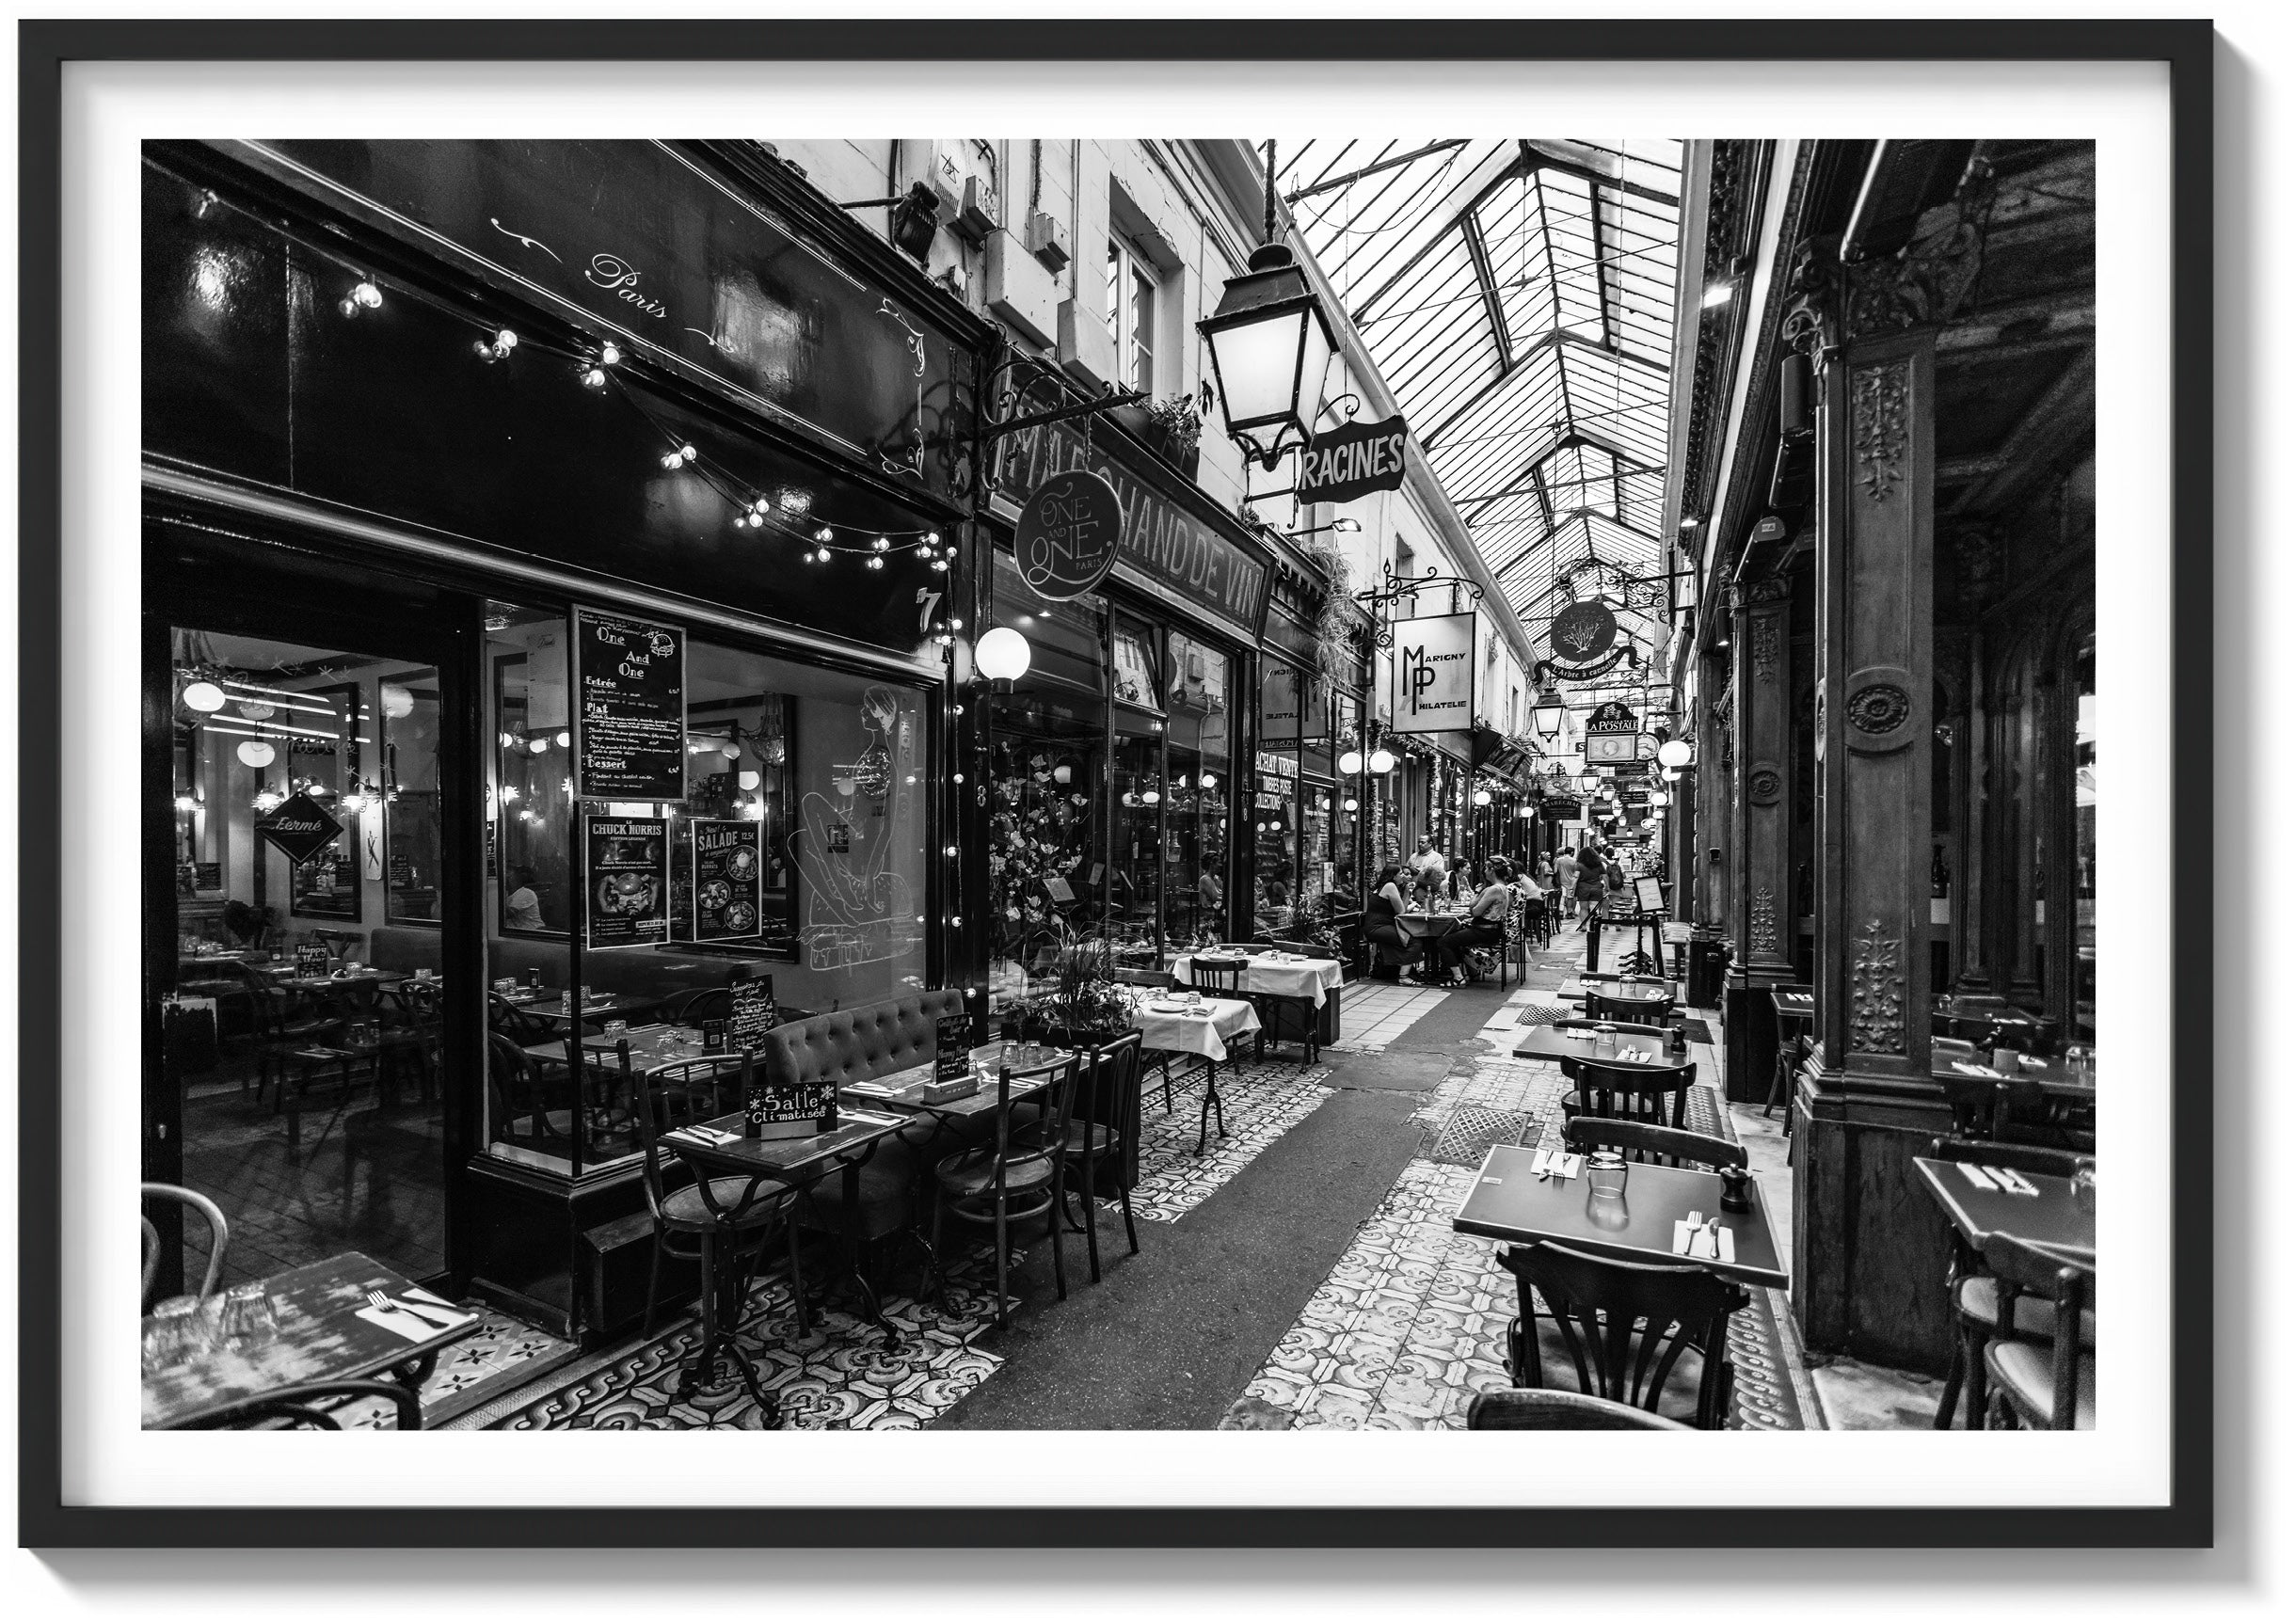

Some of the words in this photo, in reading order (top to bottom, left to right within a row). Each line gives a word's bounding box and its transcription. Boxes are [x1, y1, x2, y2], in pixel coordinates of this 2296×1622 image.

[584, 253, 667, 318] Paris
[1301, 433, 1404, 490] RACINES
[1040, 488, 1092, 528] ONE
[1008, 421, 1188, 576] MAHAND
[1188, 532, 1225, 598] DE
[1225, 550, 1261, 620] VIN
[1046, 527, 1066, 540] AND
[1028, 520, 1103, 570] ONE
[1076, 557, 1103, 571] PARIS
[916, 586, 942, 633] 7
[596, 626, 625, 645] One
[626, 650, 649, 664] And
[618, 662, 645, 677] One
[585, 676, 616, 688] Entrée
[586, 702, 609, 713] Plat
[1599, 721, 1638, 731] POSTALE
[587, 758, 627, 769] Dessert
[1255, 751, 1277, 774] ACHAT
[1278, 755, 1299, 779] VENTE
[276, 817, 322, 832] Fermé
[592, 823, 627, 835] CHUCK
[629, 824, 662, 835] NORRIS
[698, 831, 738, 851] SALADE
[297, 945, 327, 958] Happy
[763, 1090, 819, 1111] Salle
[752, 1107, 826, 1123] Climatisée
